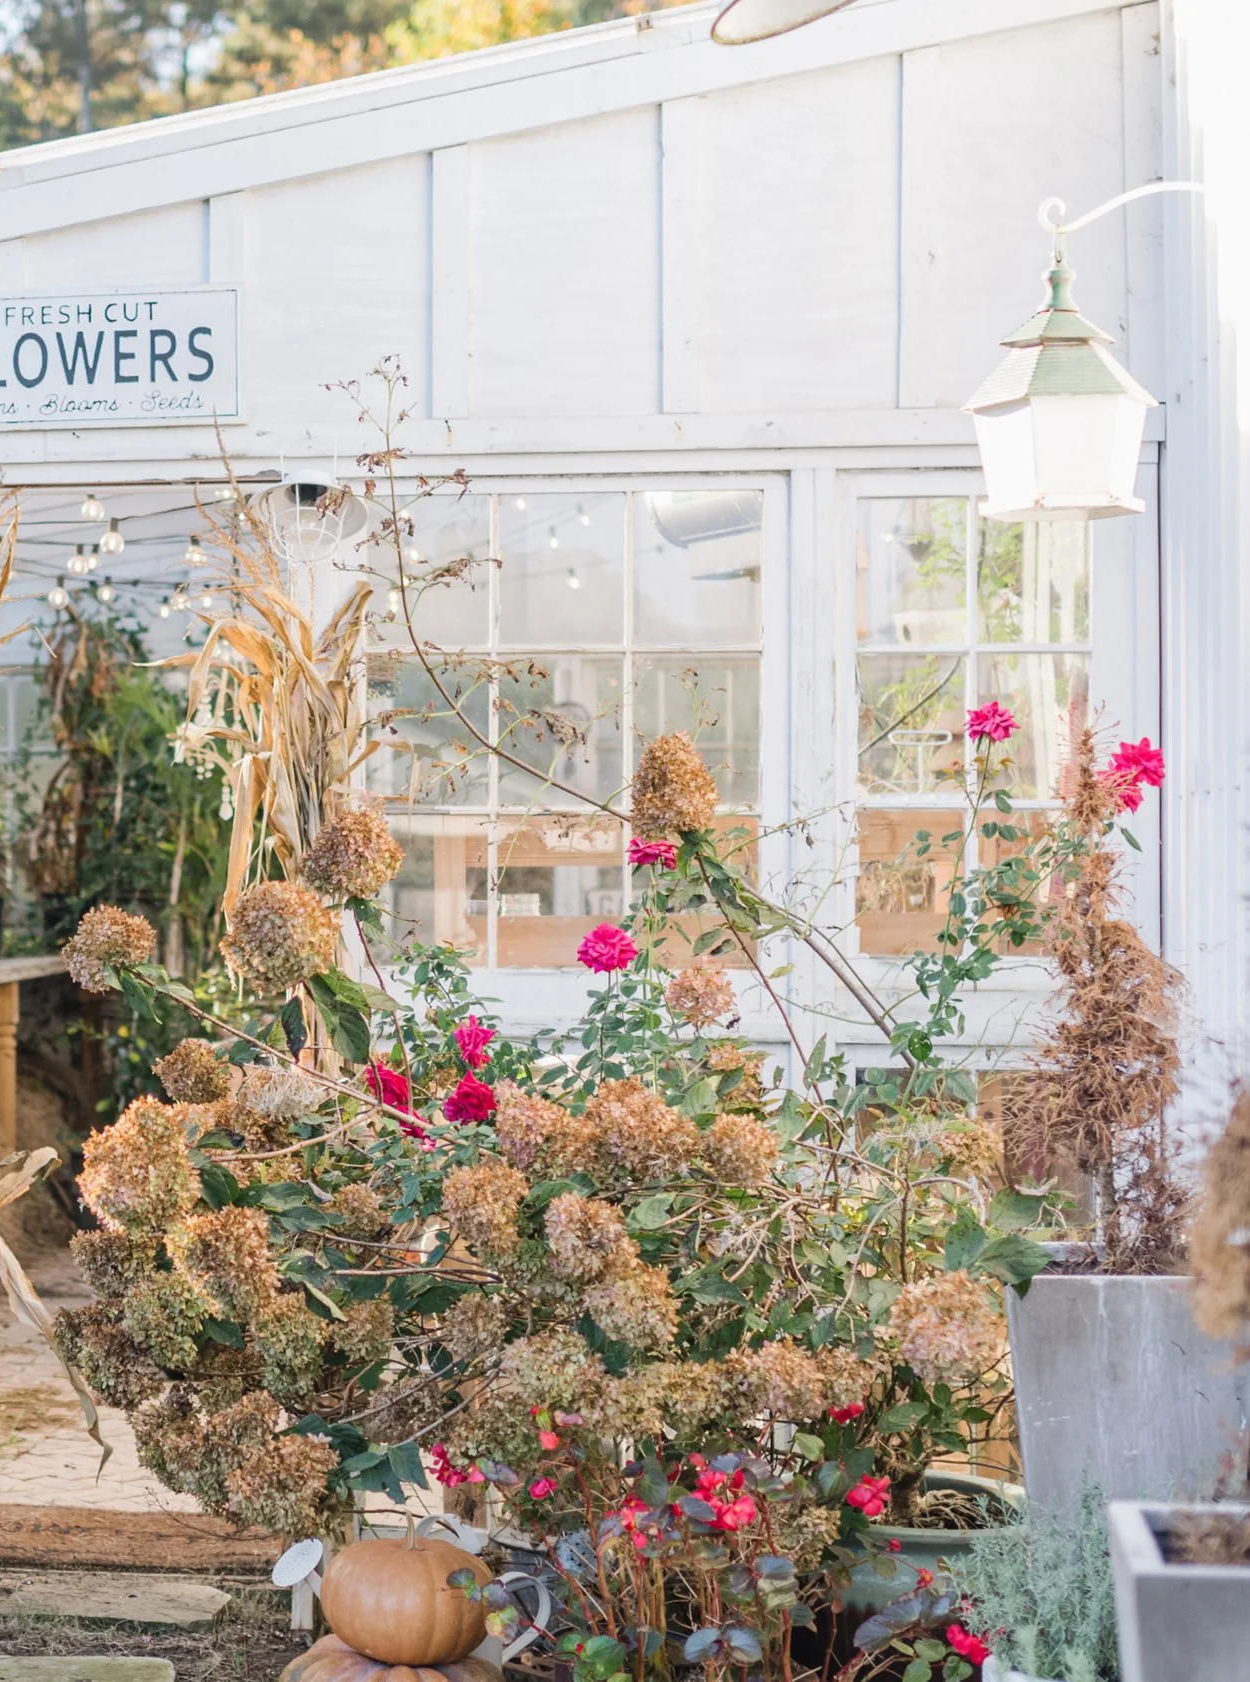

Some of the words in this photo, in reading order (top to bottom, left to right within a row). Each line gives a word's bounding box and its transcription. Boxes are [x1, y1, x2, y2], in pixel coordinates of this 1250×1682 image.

[5, 304, 92, 326] FRESH
[104, 301, 158, 323] CUT
[38, 393, 120, 416] Blooms
[140, 389, 205, 412] Seeds
